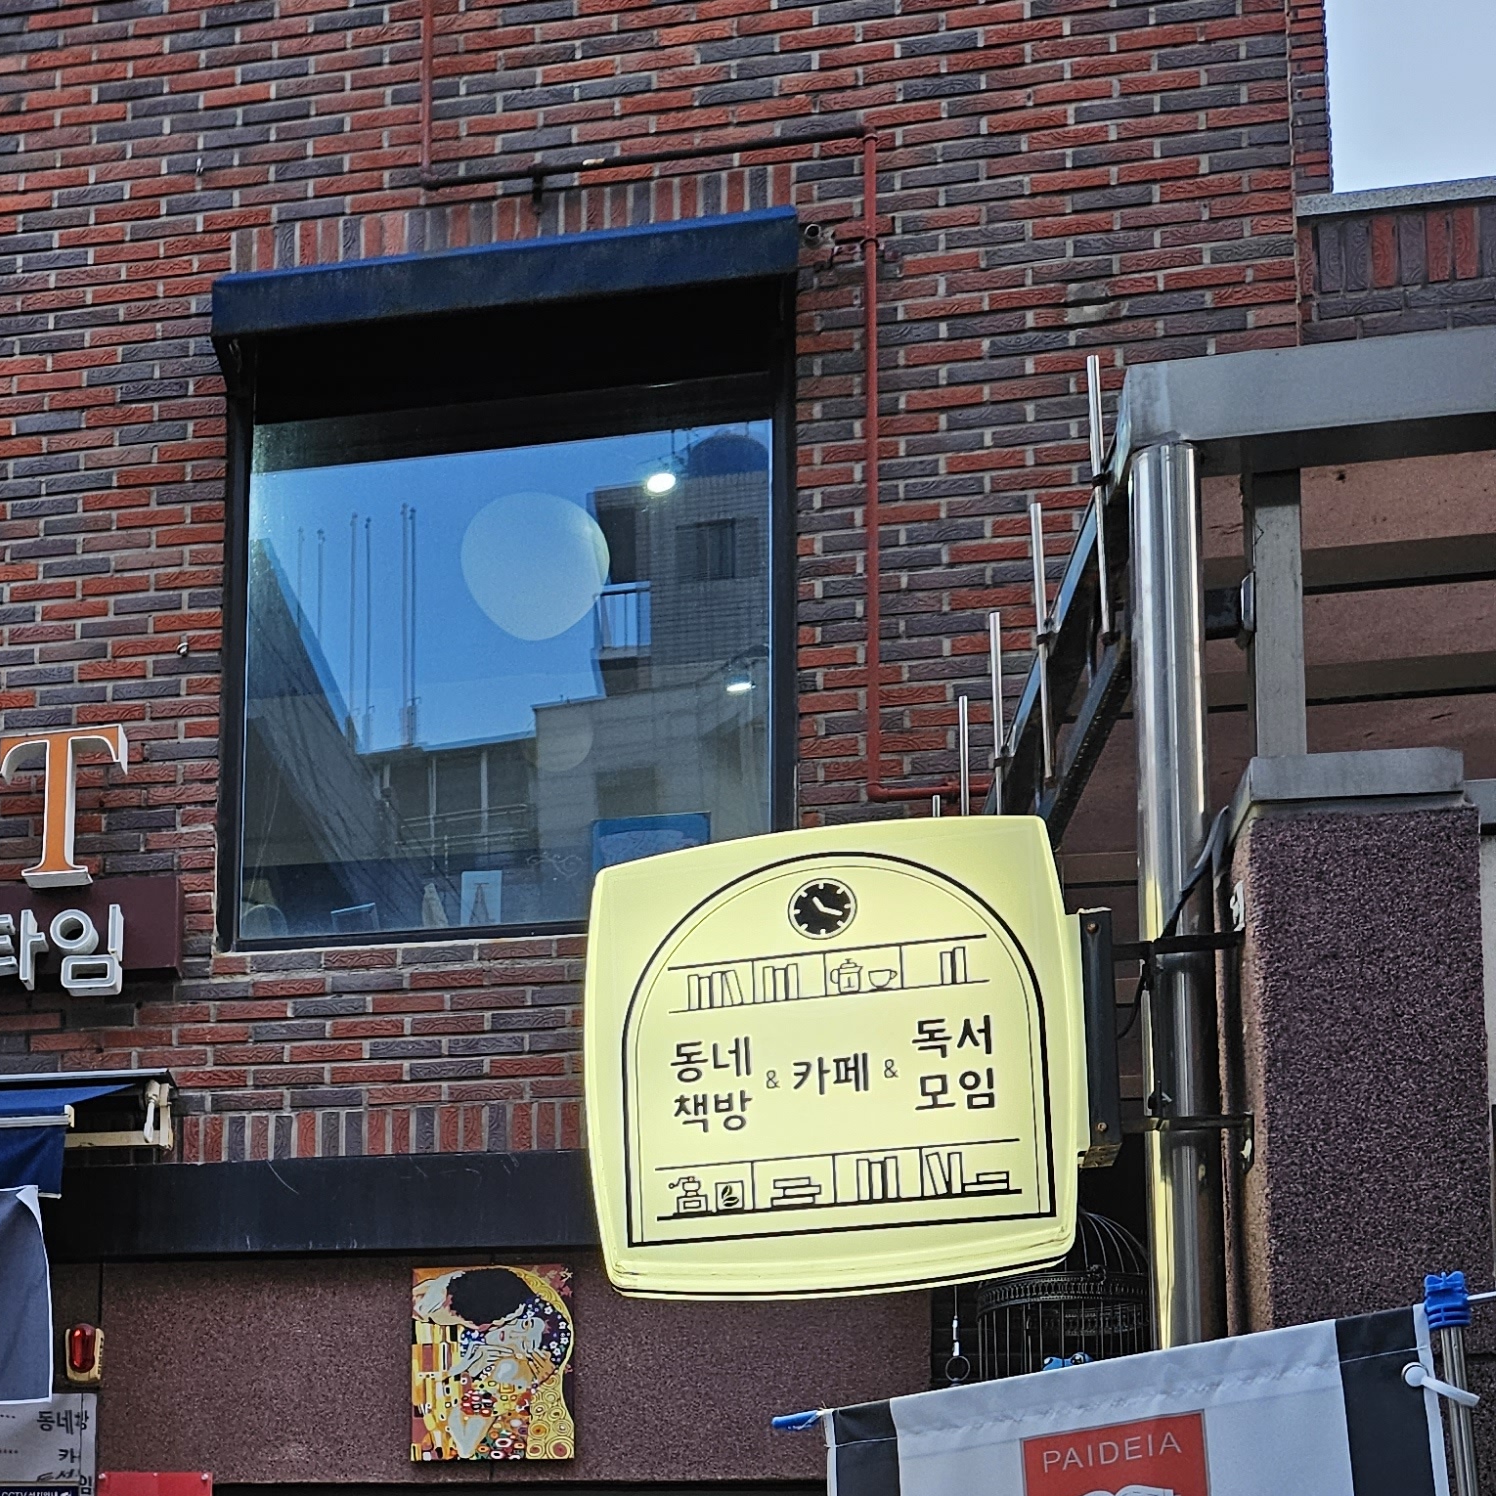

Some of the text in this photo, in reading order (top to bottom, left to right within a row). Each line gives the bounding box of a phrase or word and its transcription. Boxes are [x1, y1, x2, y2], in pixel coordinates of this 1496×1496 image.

[670, 1035, 753, 1082] 동네
[911, 1014, 993, 1060] 독서
[791, 1051, 870, 1095] 카페
[915, 1067, 997, 1110] 모임
[673, 1088, 754, 1133] 책방
[1042, 1429, 1182, 1474] PAIDEIA
